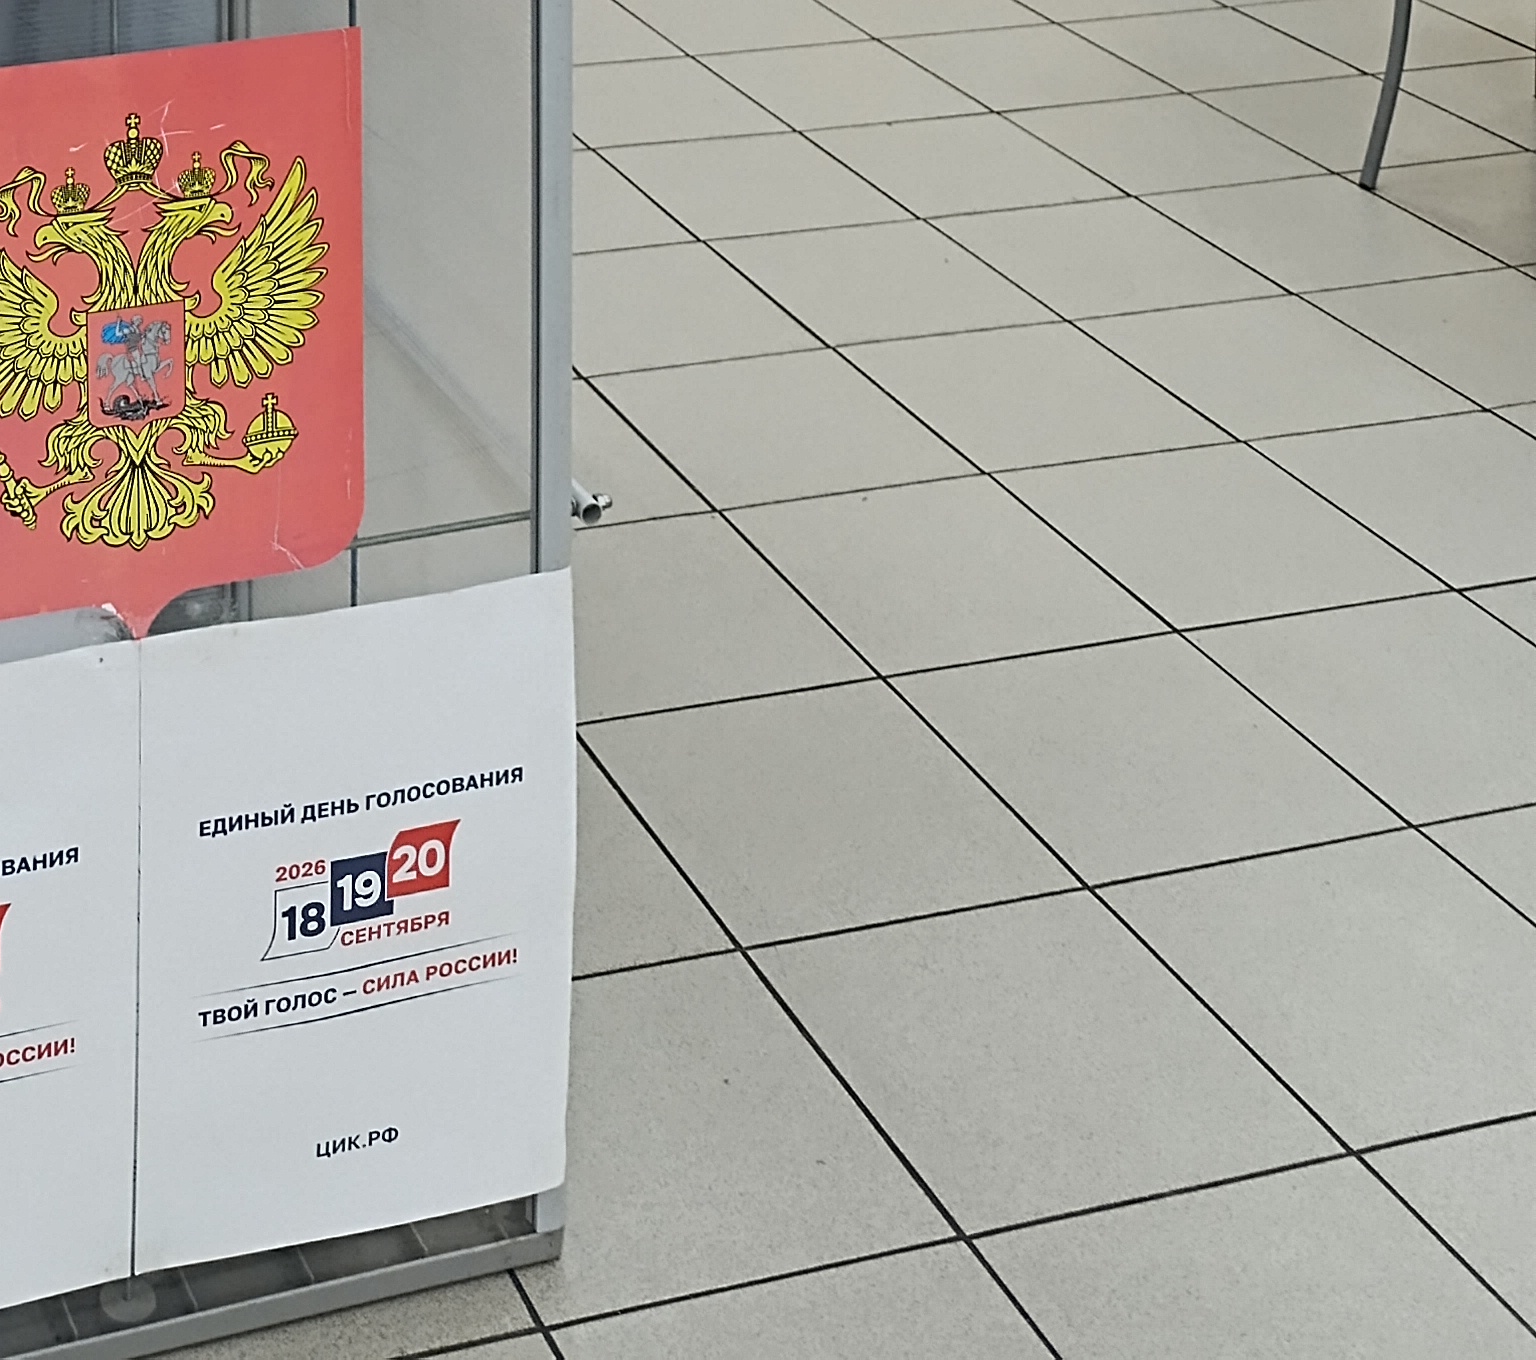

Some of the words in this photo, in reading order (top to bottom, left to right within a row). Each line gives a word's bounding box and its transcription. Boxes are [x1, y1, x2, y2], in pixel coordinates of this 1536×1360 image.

[199, 803, 295, 837] ЕДИНЫЙ
[301, 797, 359, 823] ДЕНЬ
[366, 766, 524, 810] ГОЛОСОВАНИЯ
[276, 859, 326, 882] 2026
[282, 902, 326, 941] 18
[337, 871, 382, 910] 19
[392, 839, 445, 882] 20
[341, 911, 450, 947] СЕНТЯБРЯ
[199, 999, 258, 1027] ТВОЙ
[265, 986, 337, 1015] ГОЛОС
[363, 969, 419, 995] СИЛА
[426, 948, 518, 981] РОССИИ!
[316, 1126, 399, 1157] ЦИК.РФ
